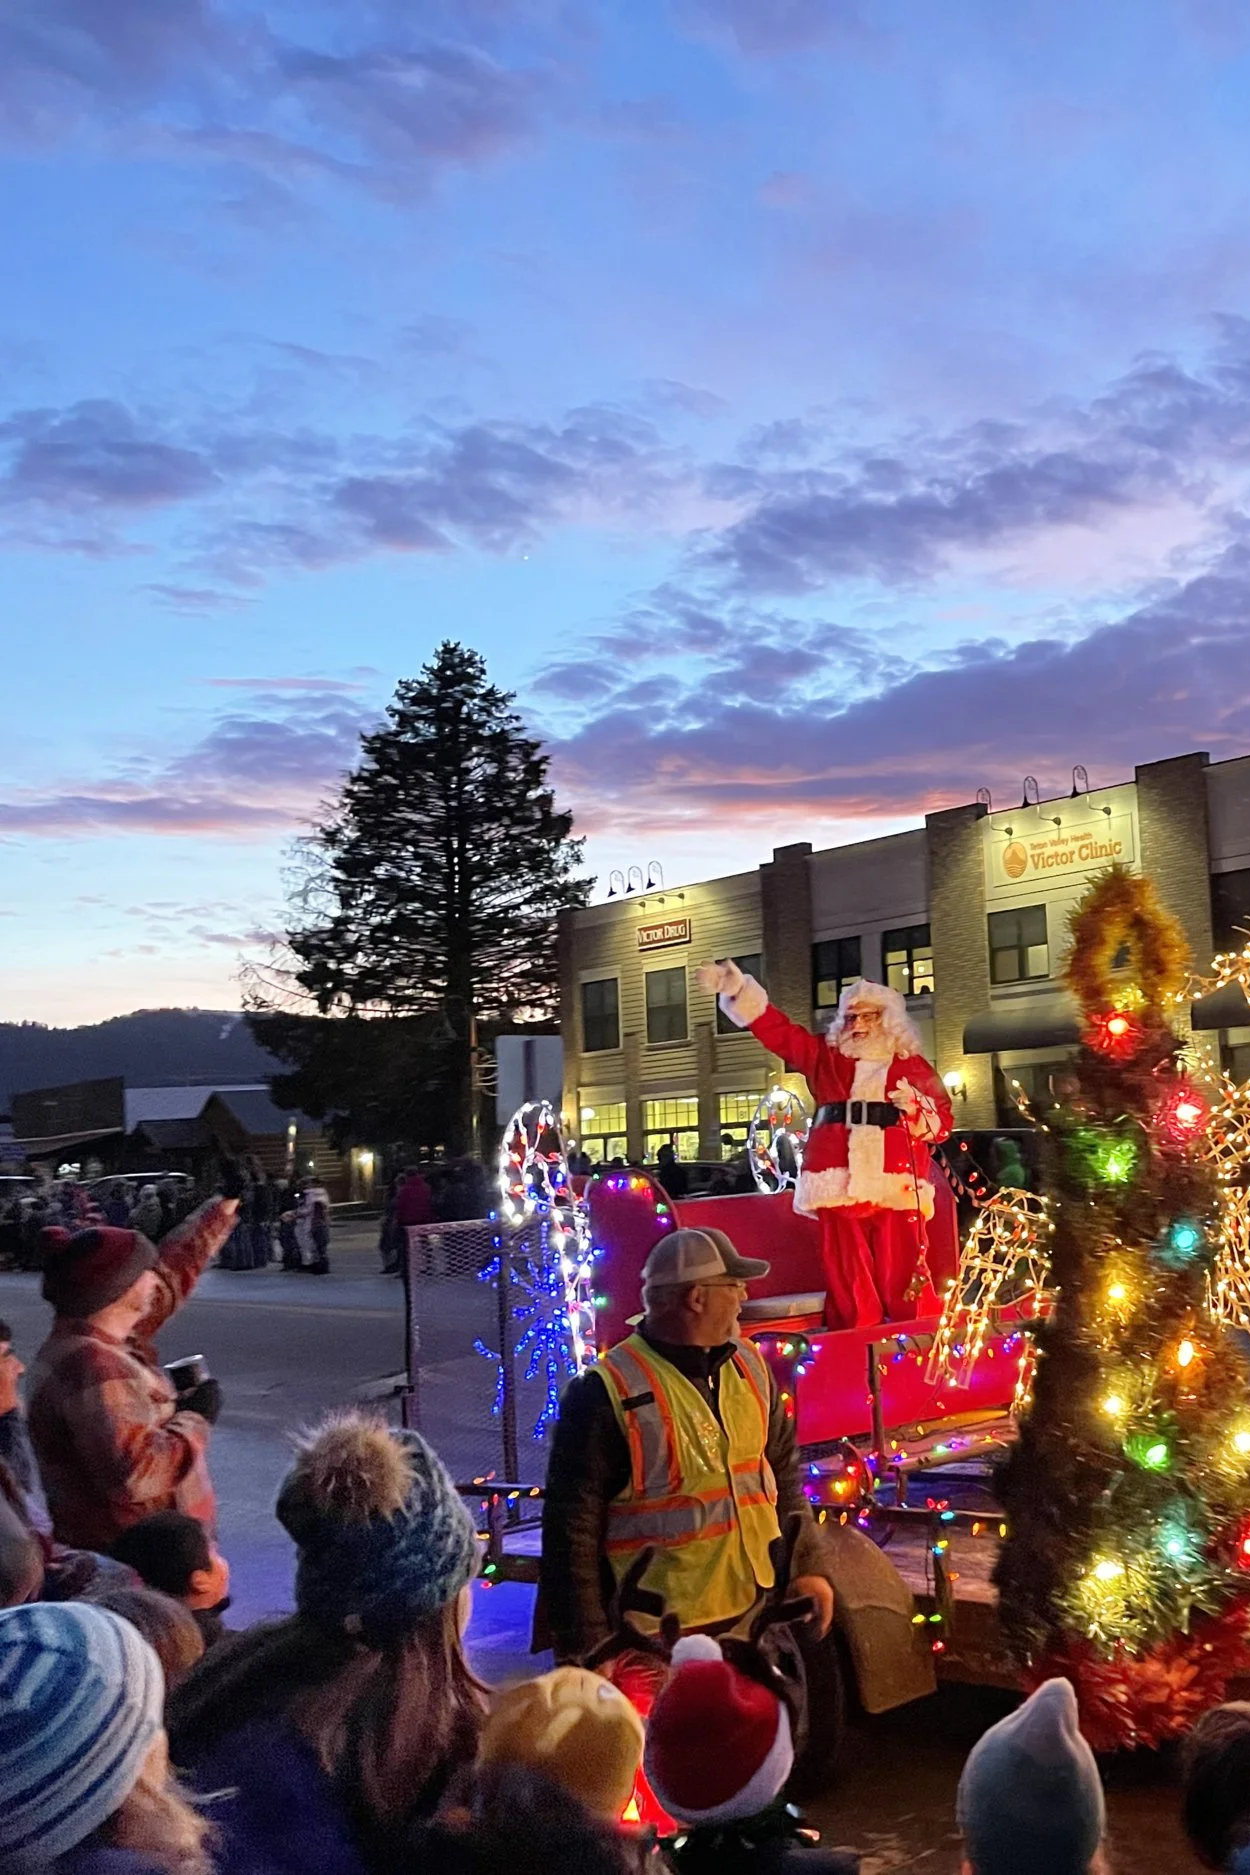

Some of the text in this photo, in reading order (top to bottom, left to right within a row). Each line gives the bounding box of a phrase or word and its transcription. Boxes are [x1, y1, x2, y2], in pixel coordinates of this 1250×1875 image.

[1030, 838, 1122, 870] Victor Clinic
[664, 924, 685, 939] DRUG
